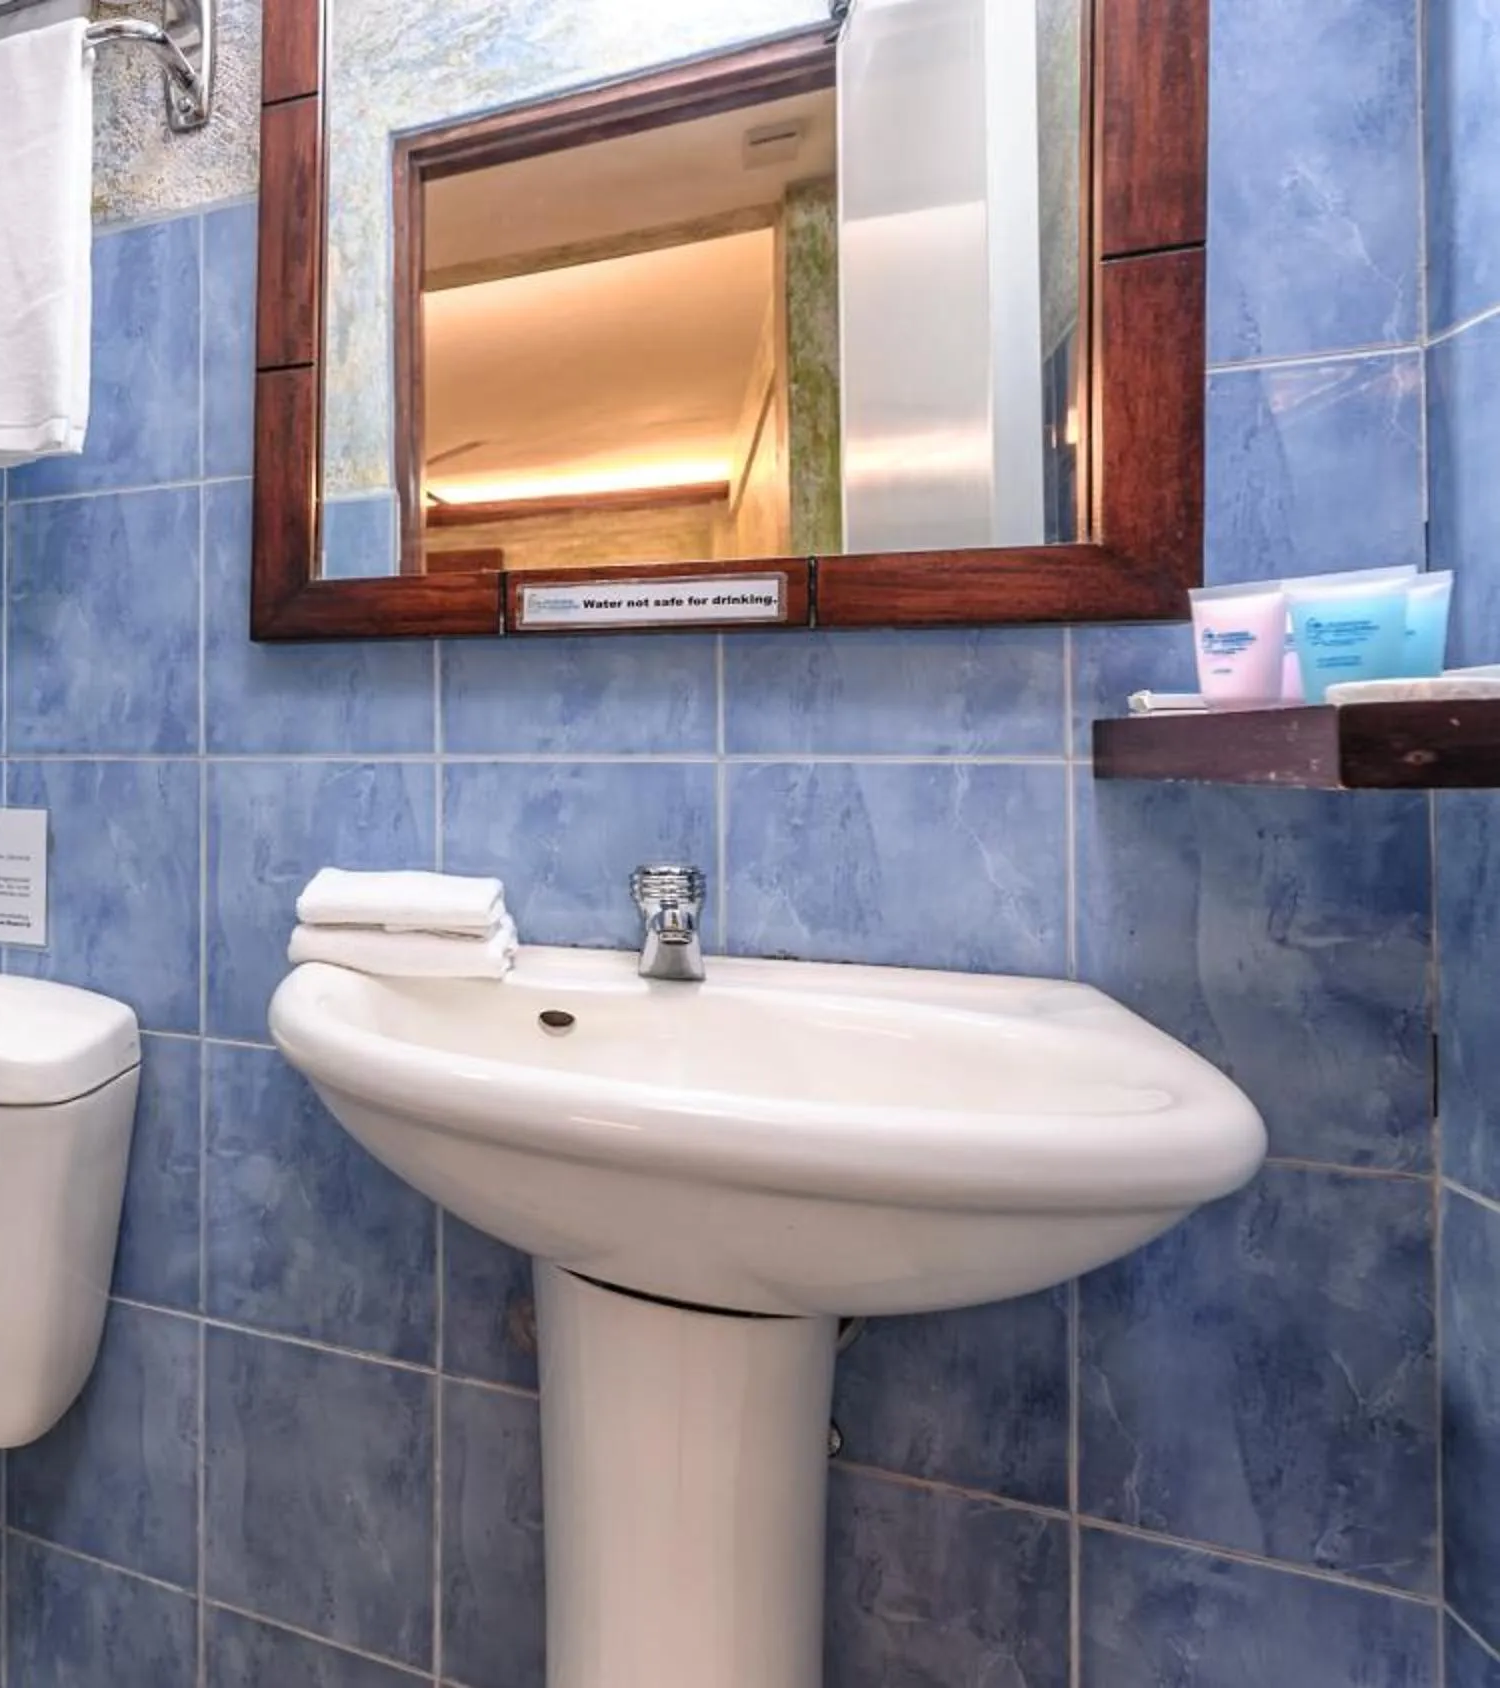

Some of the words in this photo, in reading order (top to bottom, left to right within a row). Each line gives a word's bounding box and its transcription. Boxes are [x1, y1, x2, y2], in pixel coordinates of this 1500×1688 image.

[582, 598, 623, 609] Water
[626, 598, 649, 608] not
[653, 597, 684, 607] safe
[687, 596, 708, 606] for
[711, 593, 780, 606] drinking.
